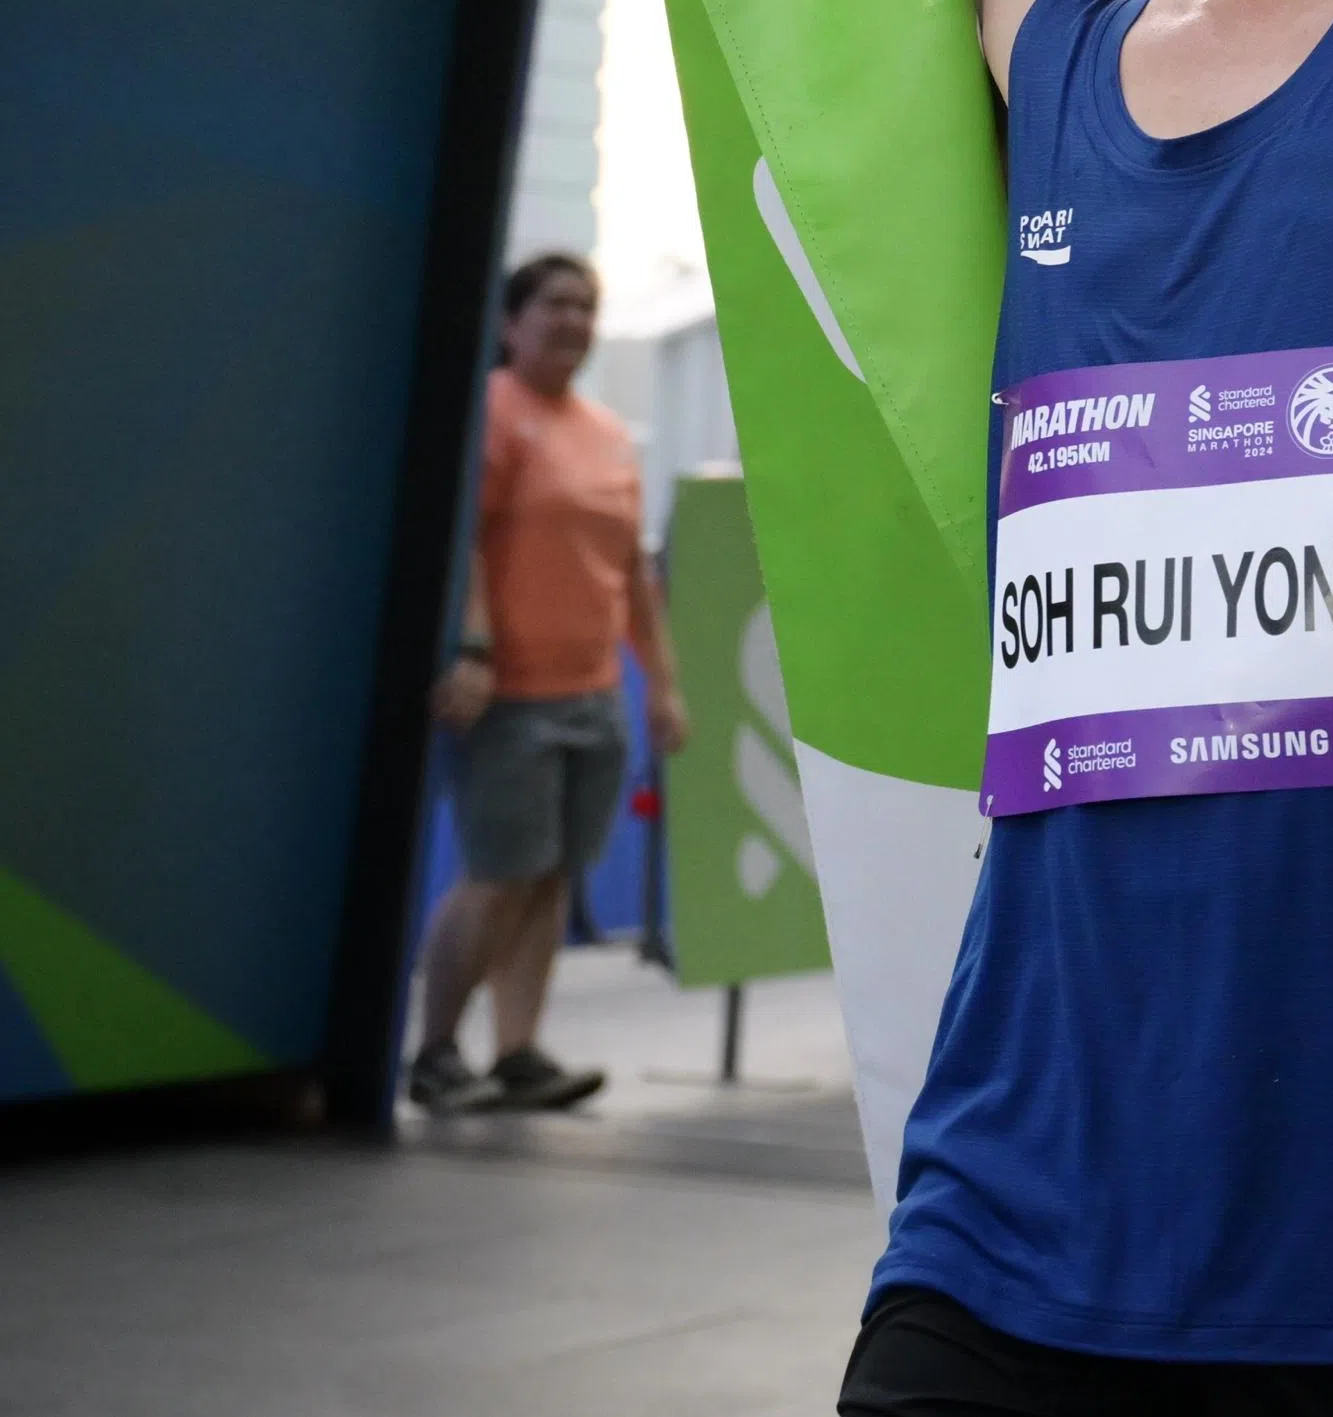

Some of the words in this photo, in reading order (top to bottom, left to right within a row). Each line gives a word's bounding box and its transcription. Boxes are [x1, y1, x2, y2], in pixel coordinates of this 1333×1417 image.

[1218, 385, 1273, 401] standard
[1218, 395, 1275, 411] chartered
[1011, 393, 1156, 450] MARATHON
[1188, 421, 1275, 443] SINGAPORE
[1187, 435, 1274, 453] MARATHON
[1244, 447, 1273, 458] 2024
[1028, 441, 1111, 474] 42.195KM
[1001, 567, 1074, 670] SOH
[1093, 556, 1193, 650] RUI
[1067, 738, 1132, 759] standard
[1170, 728, 1330, 764] SAMSUNG
[1067, 753, 1137, 775] chartered
